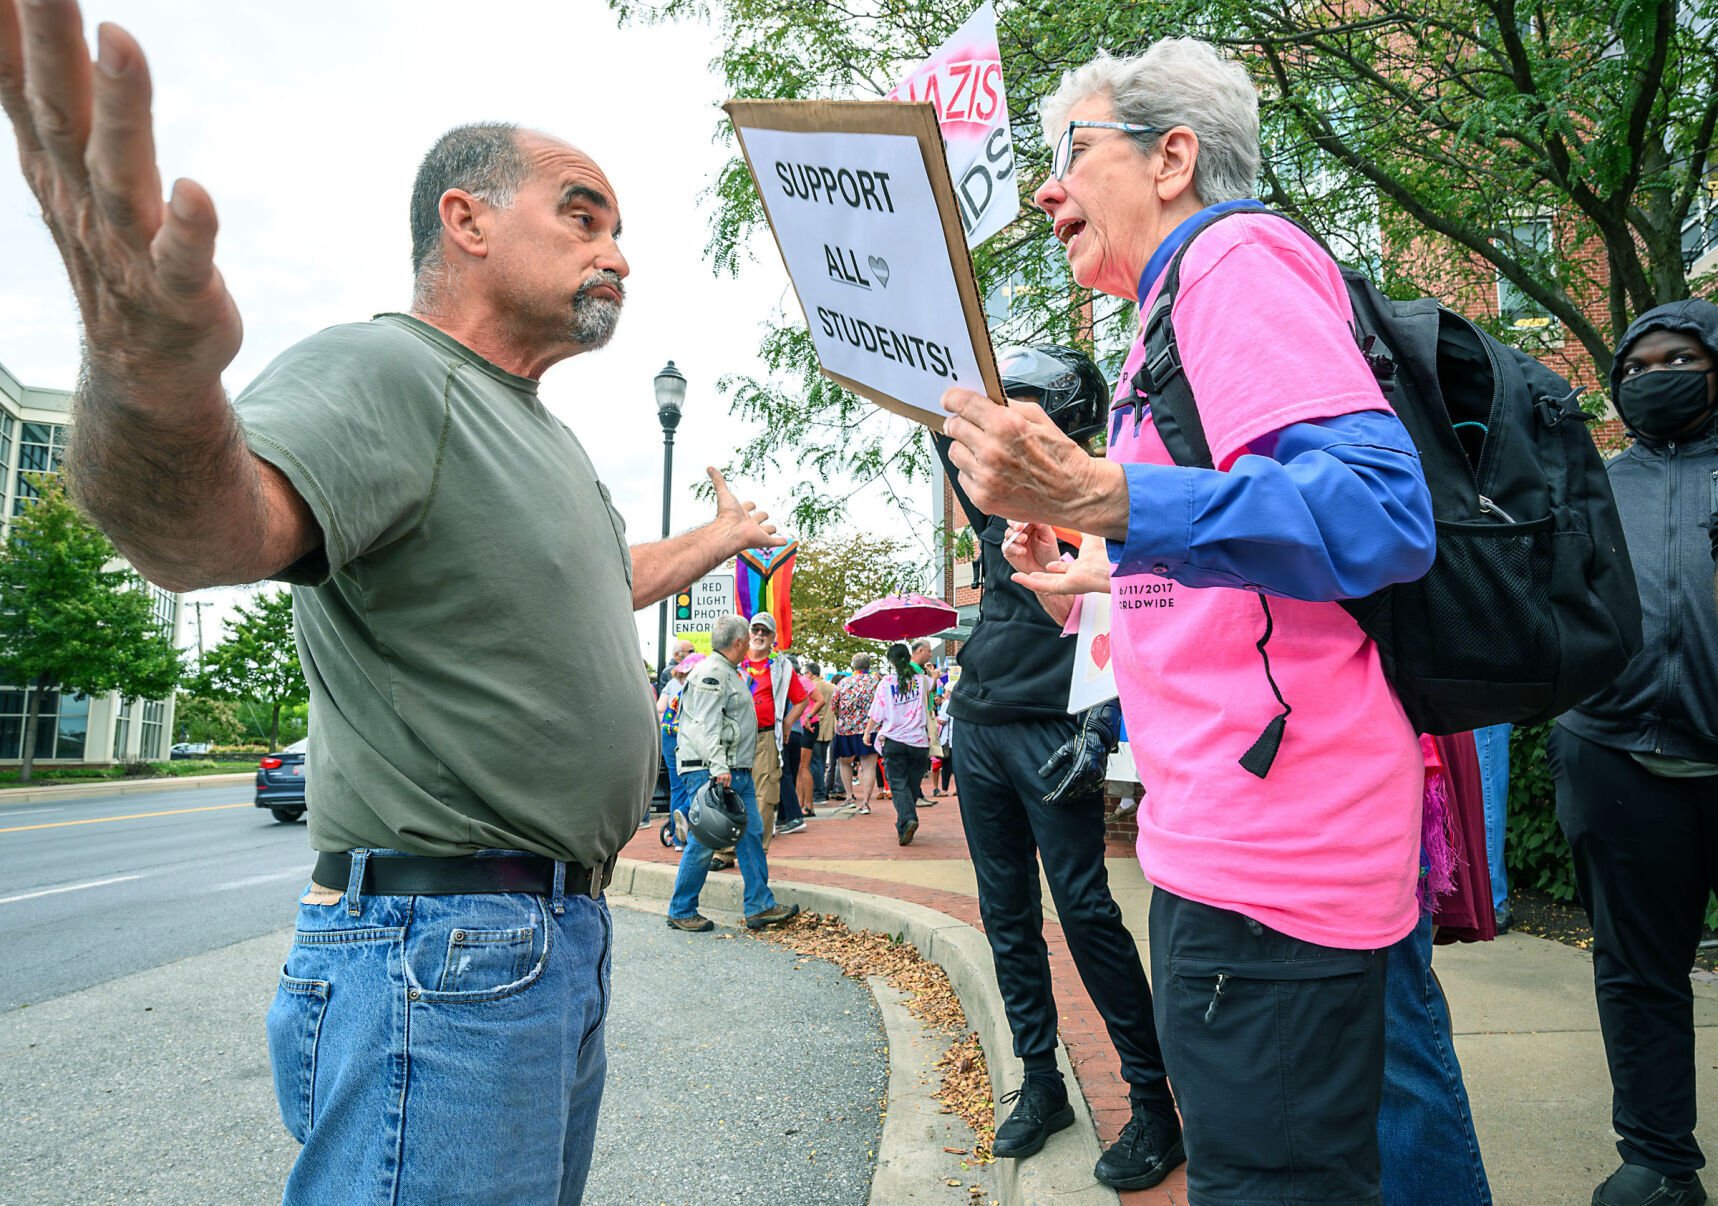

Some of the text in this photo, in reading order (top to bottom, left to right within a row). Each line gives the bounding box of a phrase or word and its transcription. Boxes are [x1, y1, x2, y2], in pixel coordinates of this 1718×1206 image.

[775, 161, 895, 213] SUPPORT
[823, 243, 871, 288] ALL
[817, 305, 958, 382] STUDENTS!
[697, 596, 727, 606] LIGHT
[702, 583, 722, 592] RED
[676, 623, 714, 633] ENFOR
